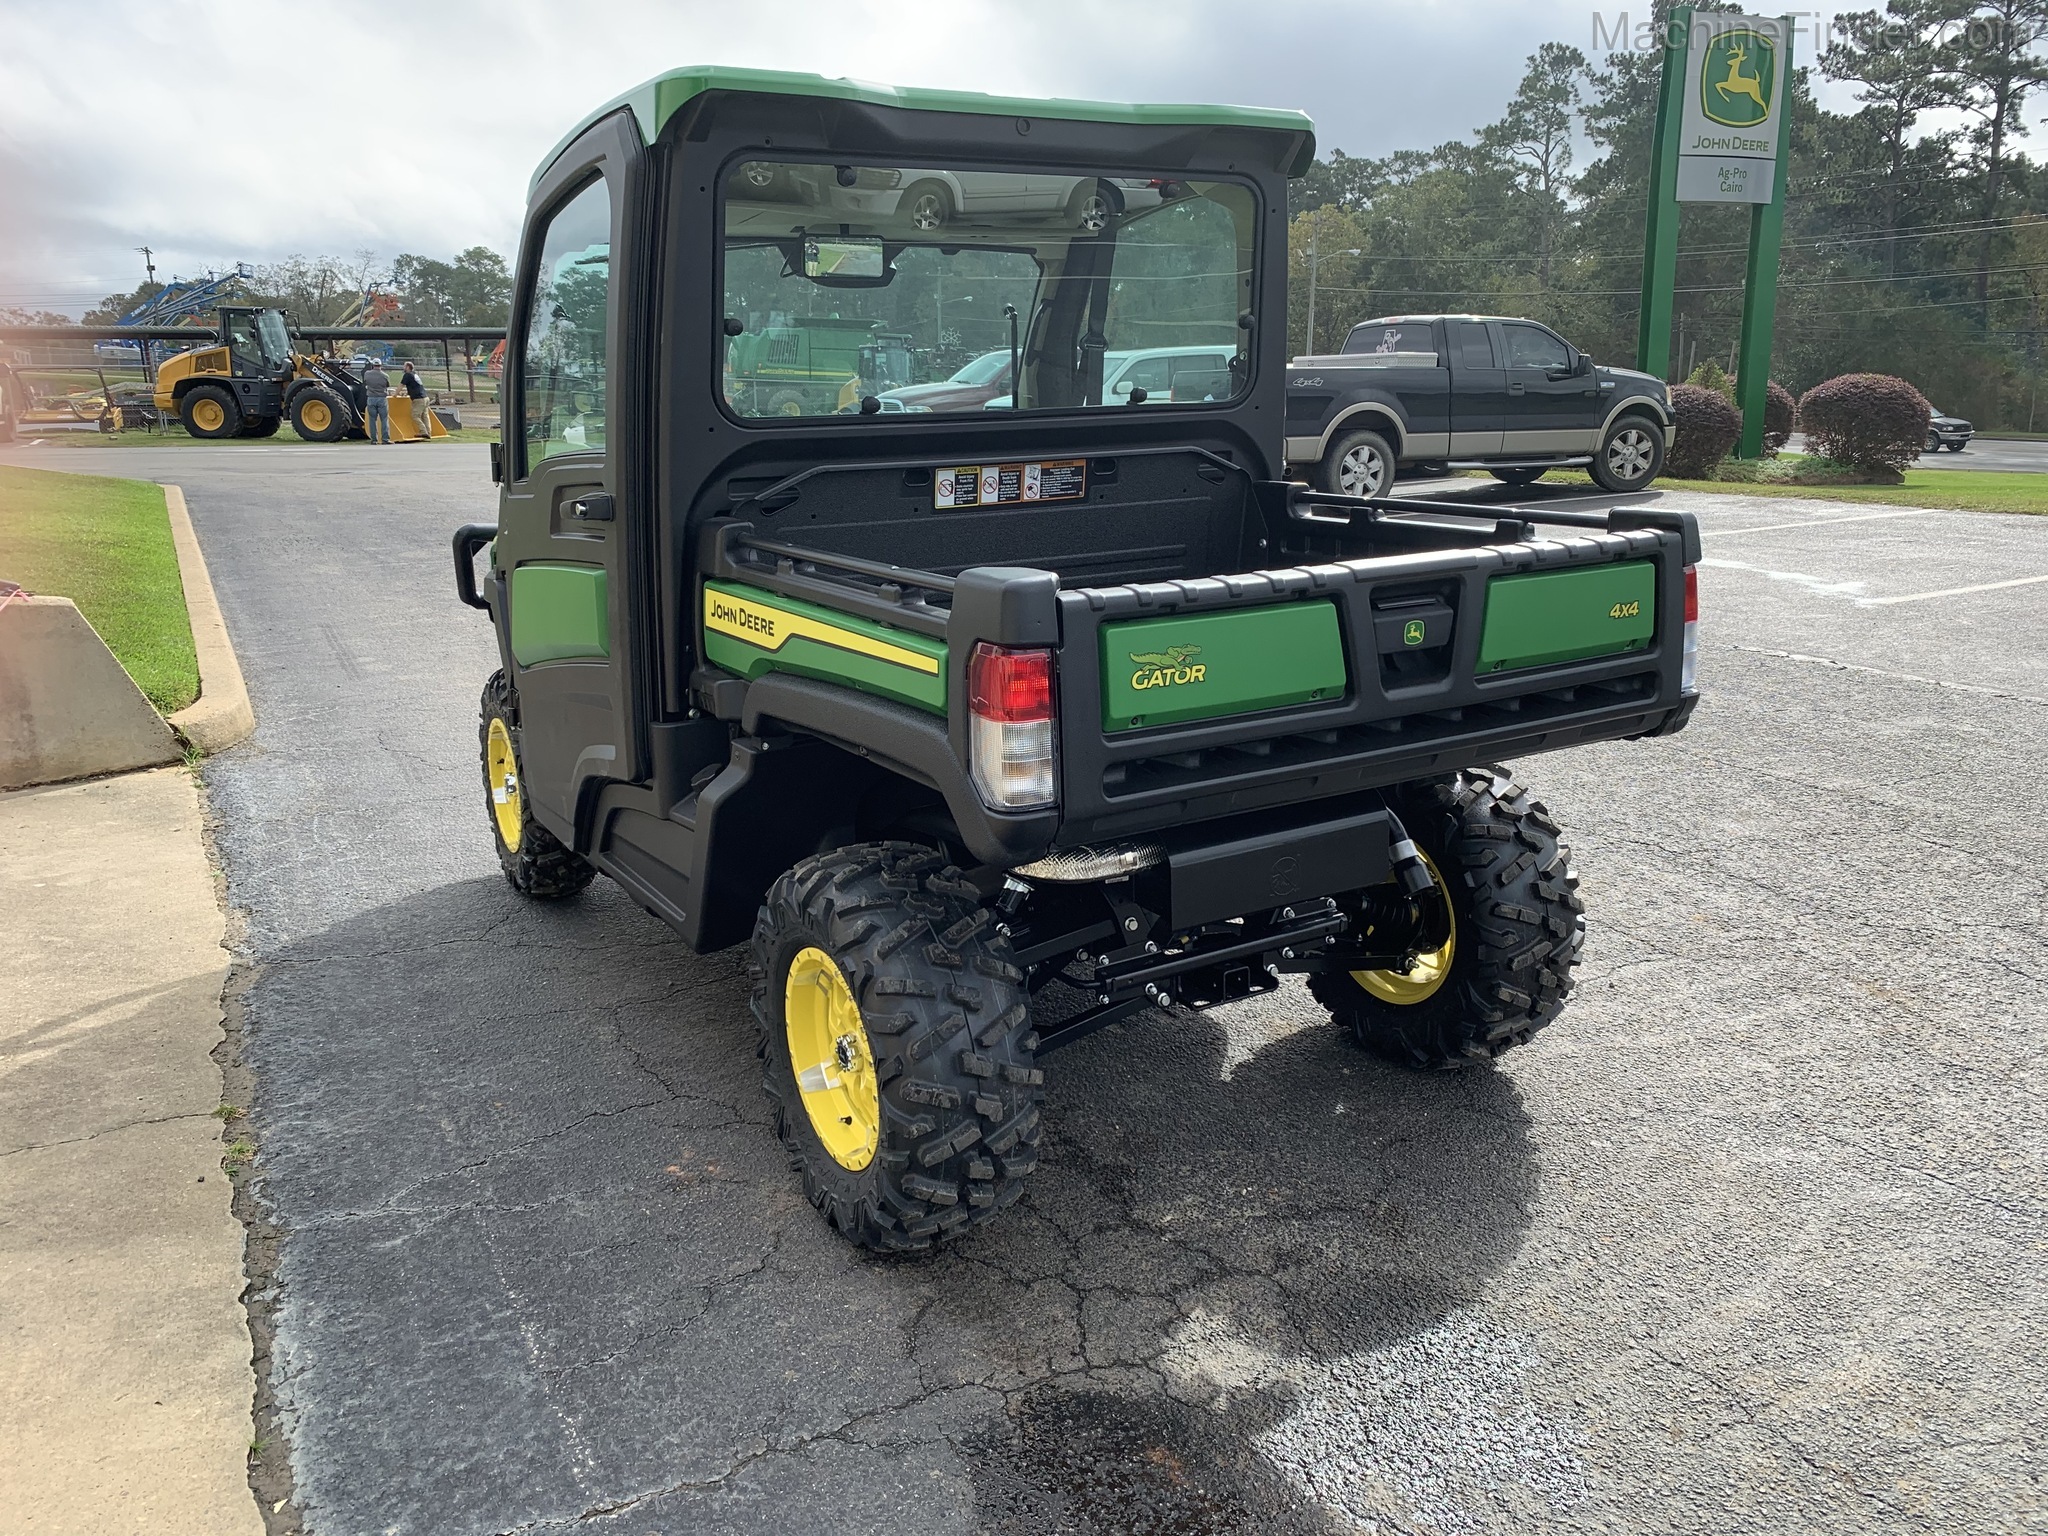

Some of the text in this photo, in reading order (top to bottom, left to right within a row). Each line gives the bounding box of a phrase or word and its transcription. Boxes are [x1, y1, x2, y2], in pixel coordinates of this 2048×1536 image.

[1692, 135, 1769, 152] JOHN DEERE
[1718, 166, 1747, 181] Ag-Pro
[1720, 181, 1743, 193] Cairo
[311, 366, 335, 385] DEERE
[711, 599, 775, 637] JOHN DEERE
[1131, 664, 1206, 690] GATOR
